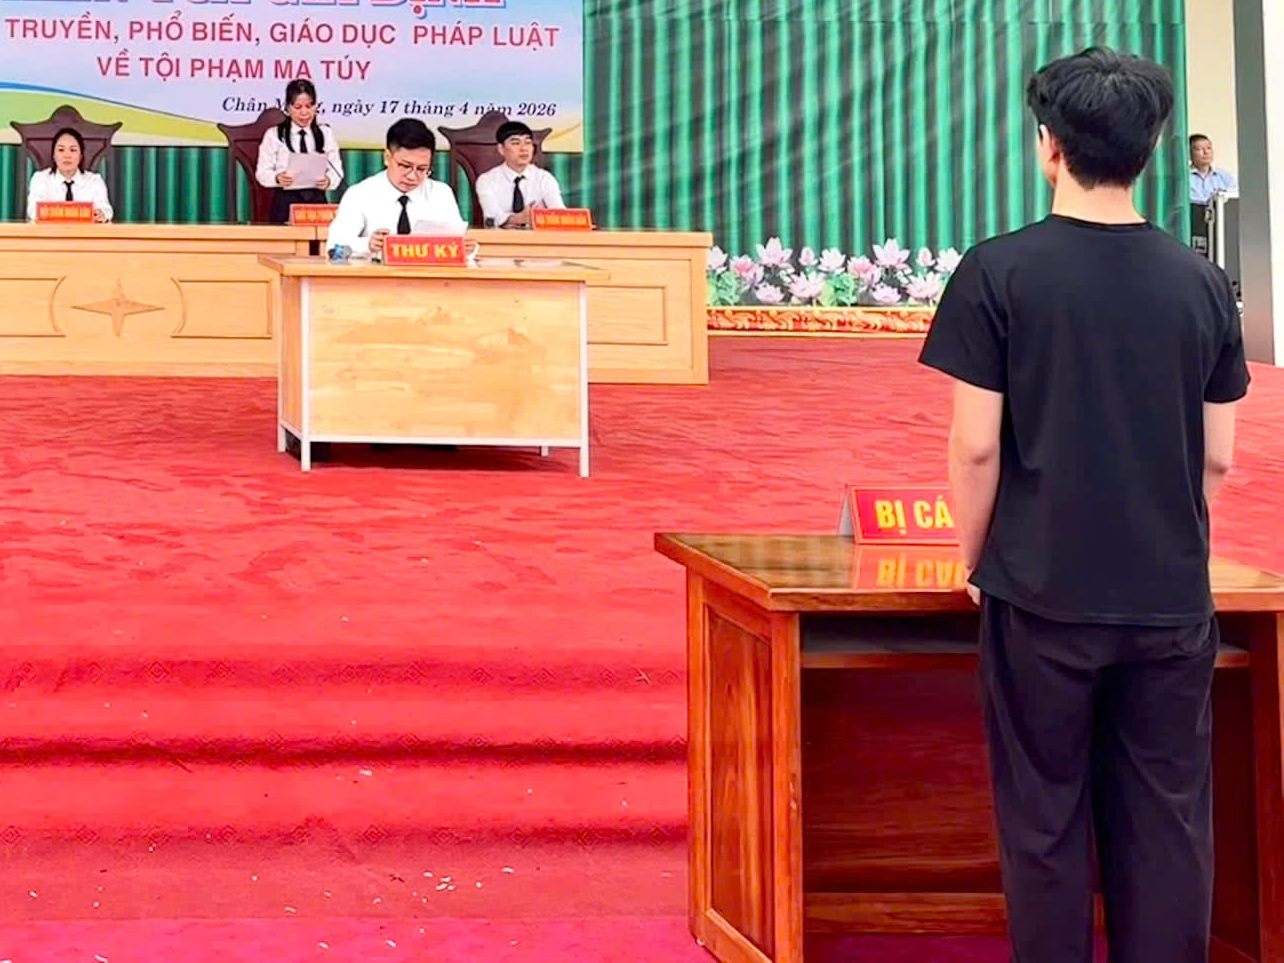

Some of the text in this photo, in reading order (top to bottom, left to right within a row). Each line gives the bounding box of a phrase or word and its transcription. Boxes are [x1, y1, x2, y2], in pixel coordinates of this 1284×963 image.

[5, 11, 119, 44] TRUYỀN,
[129, 10, 184, 40] PHỔ
[192, 13, 260, 45] BIẾN,
[269, 18, 334, 44] GIÁO
[342, 24, 397, 48] DỤC
[413, 21, 484, 46] PHÁP
[493, 23, 560, 51] LUẬT
[97, 49, 371, 83] VỀ TỘI PHẠM MA TÚY
[222, 96, 268, 112] Chân
[332, 99, 375, 117] ngày
[380, 100, 400, 114] 17
[404, 100, 456, 117] tháng
[459, 102, 470, 115] 4
[517, 102, 558, 117] 2026
[389, 242, 430, 258] THƯ
[875, 493, 957, 536] BỊ CÁ
